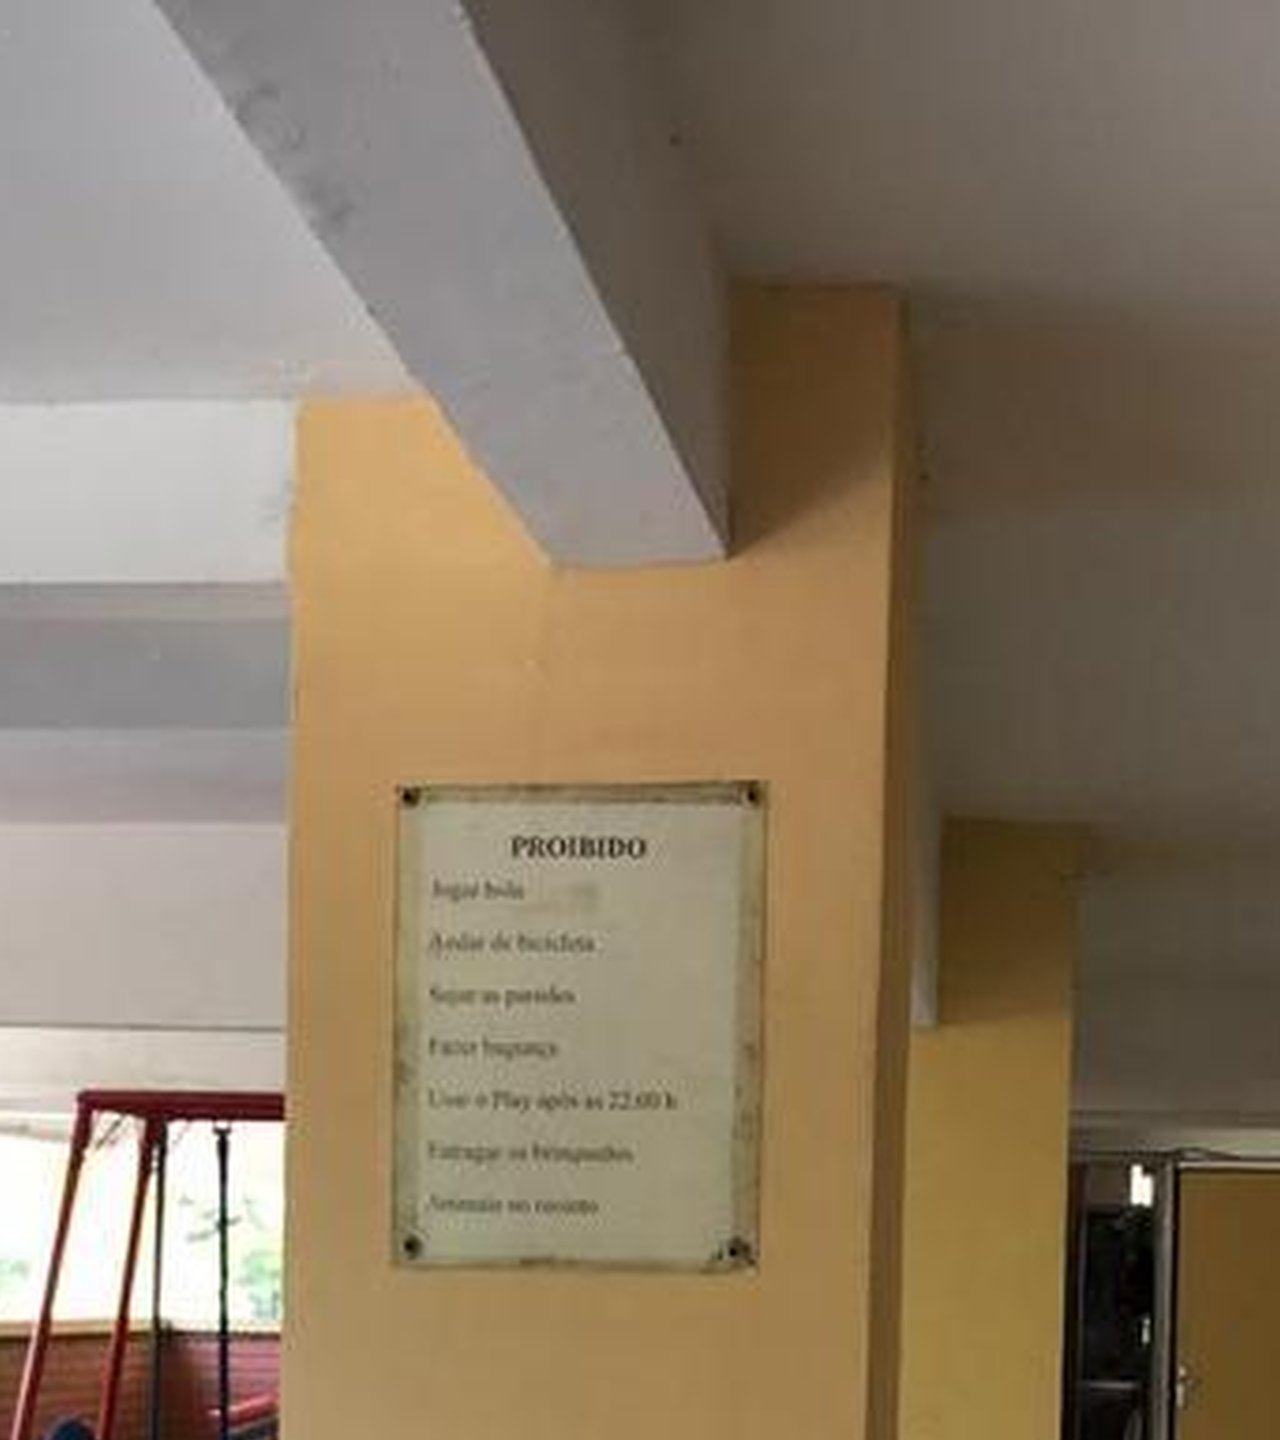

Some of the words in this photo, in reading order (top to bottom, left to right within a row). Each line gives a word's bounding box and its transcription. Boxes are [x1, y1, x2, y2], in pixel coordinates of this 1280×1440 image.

[511, 835, 647, 860] PROIBIDO
[432, 877, 479, 903] Jogar
[429, 931, 485, 952] Andar
[489, 931, 511, 951] de
[516, 932, 596, 952] bicicleta
[505, 983, 577, 1010] paredes
[492, 1089, 531, 1115] Play
